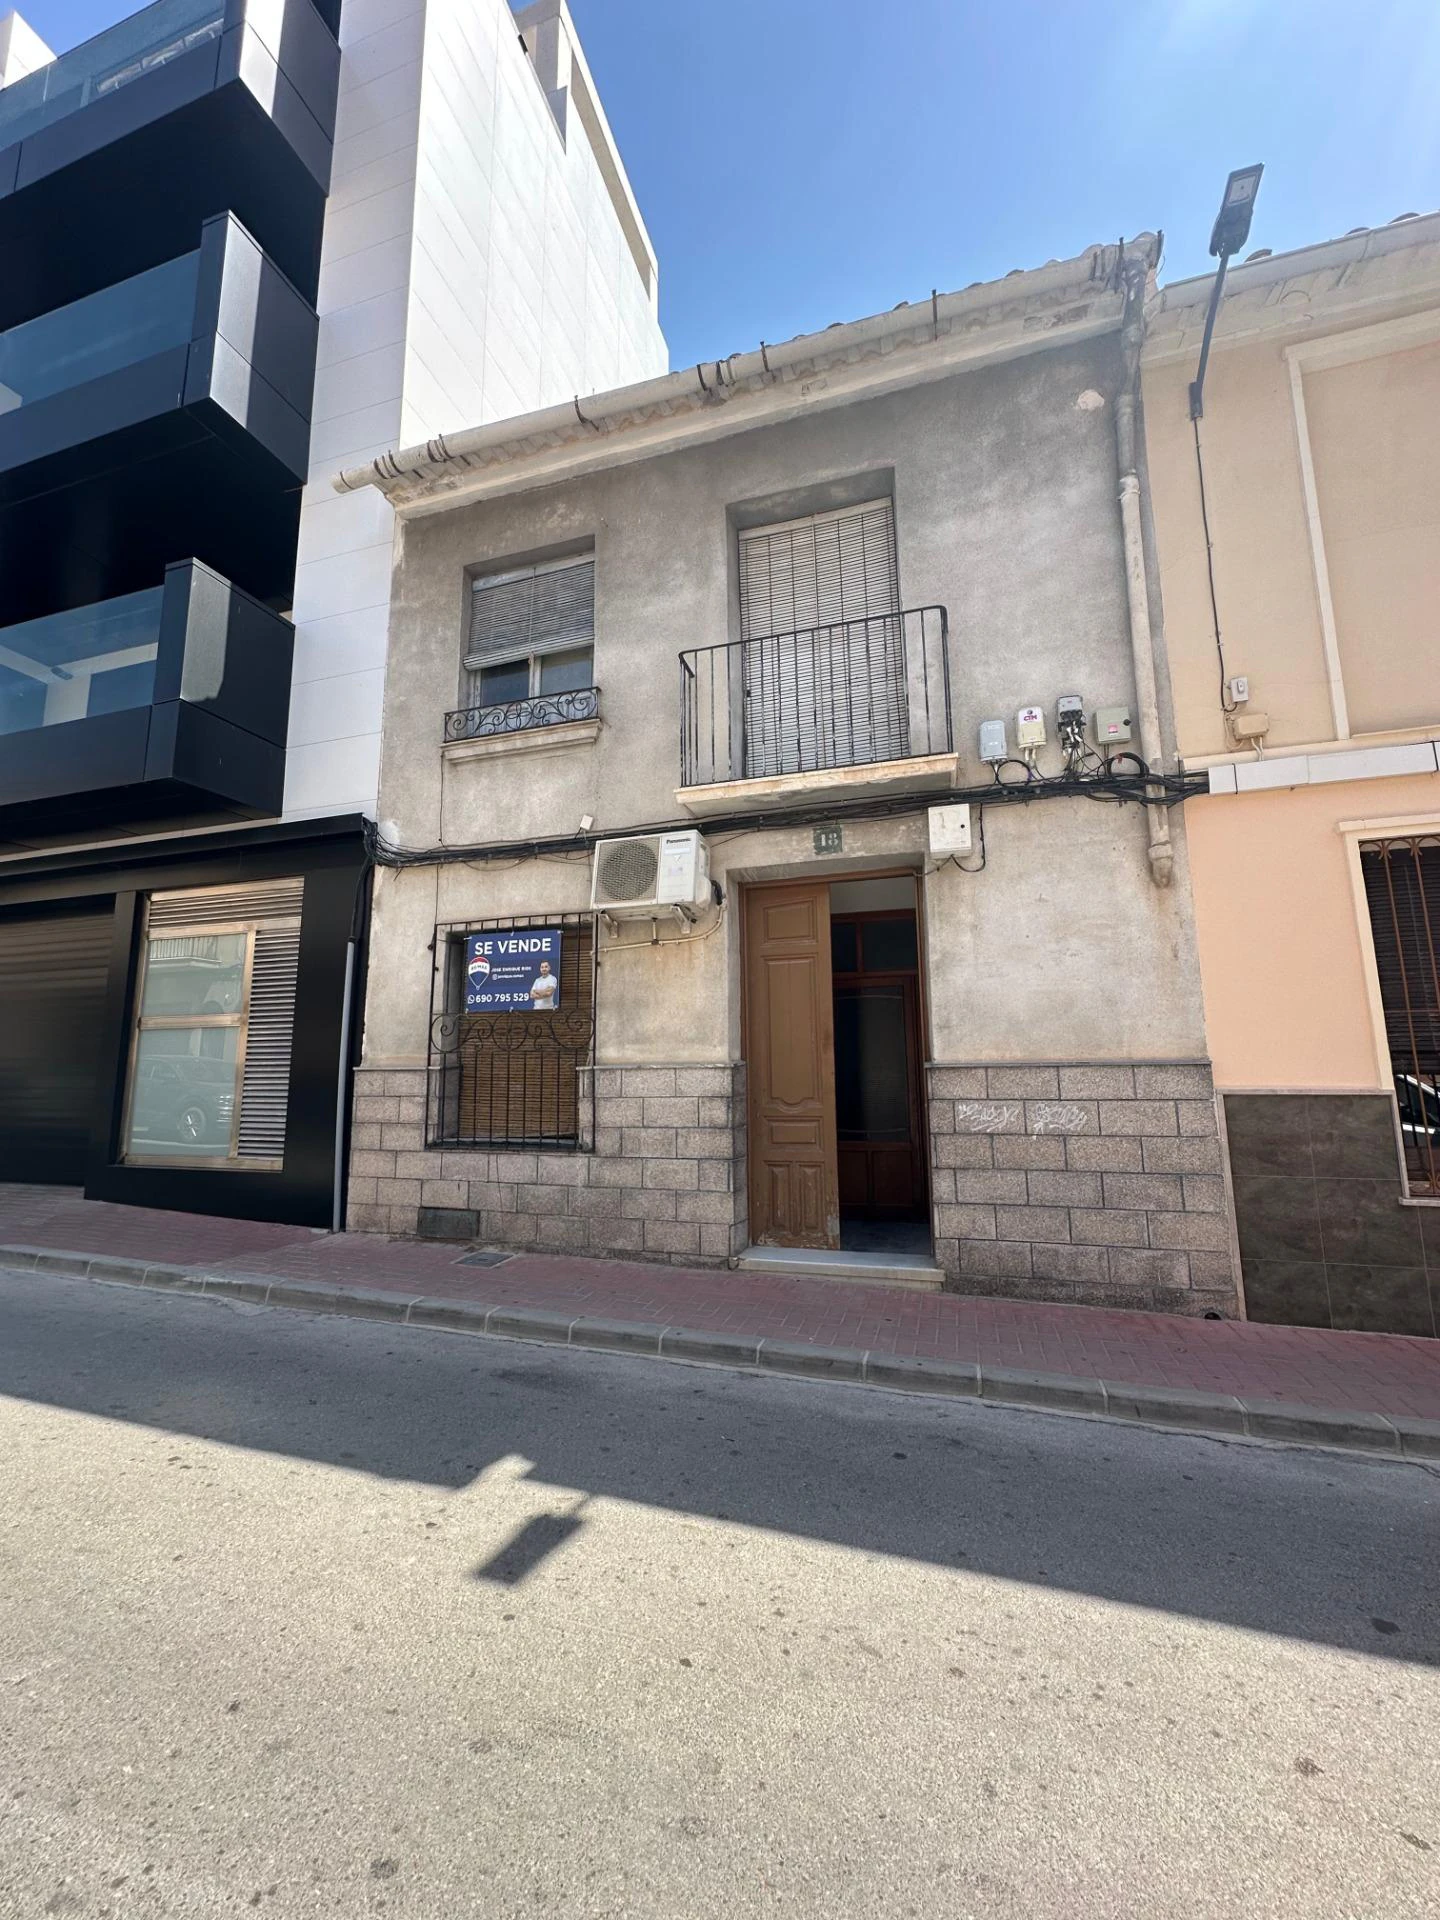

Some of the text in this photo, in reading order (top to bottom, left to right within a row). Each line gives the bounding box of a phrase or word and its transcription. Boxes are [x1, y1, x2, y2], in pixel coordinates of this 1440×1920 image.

[821, 833, 839, 847] 18
[474, 938, 552, 955] SE VENDE
[475, 992, 529, 1003] 690 795 529
